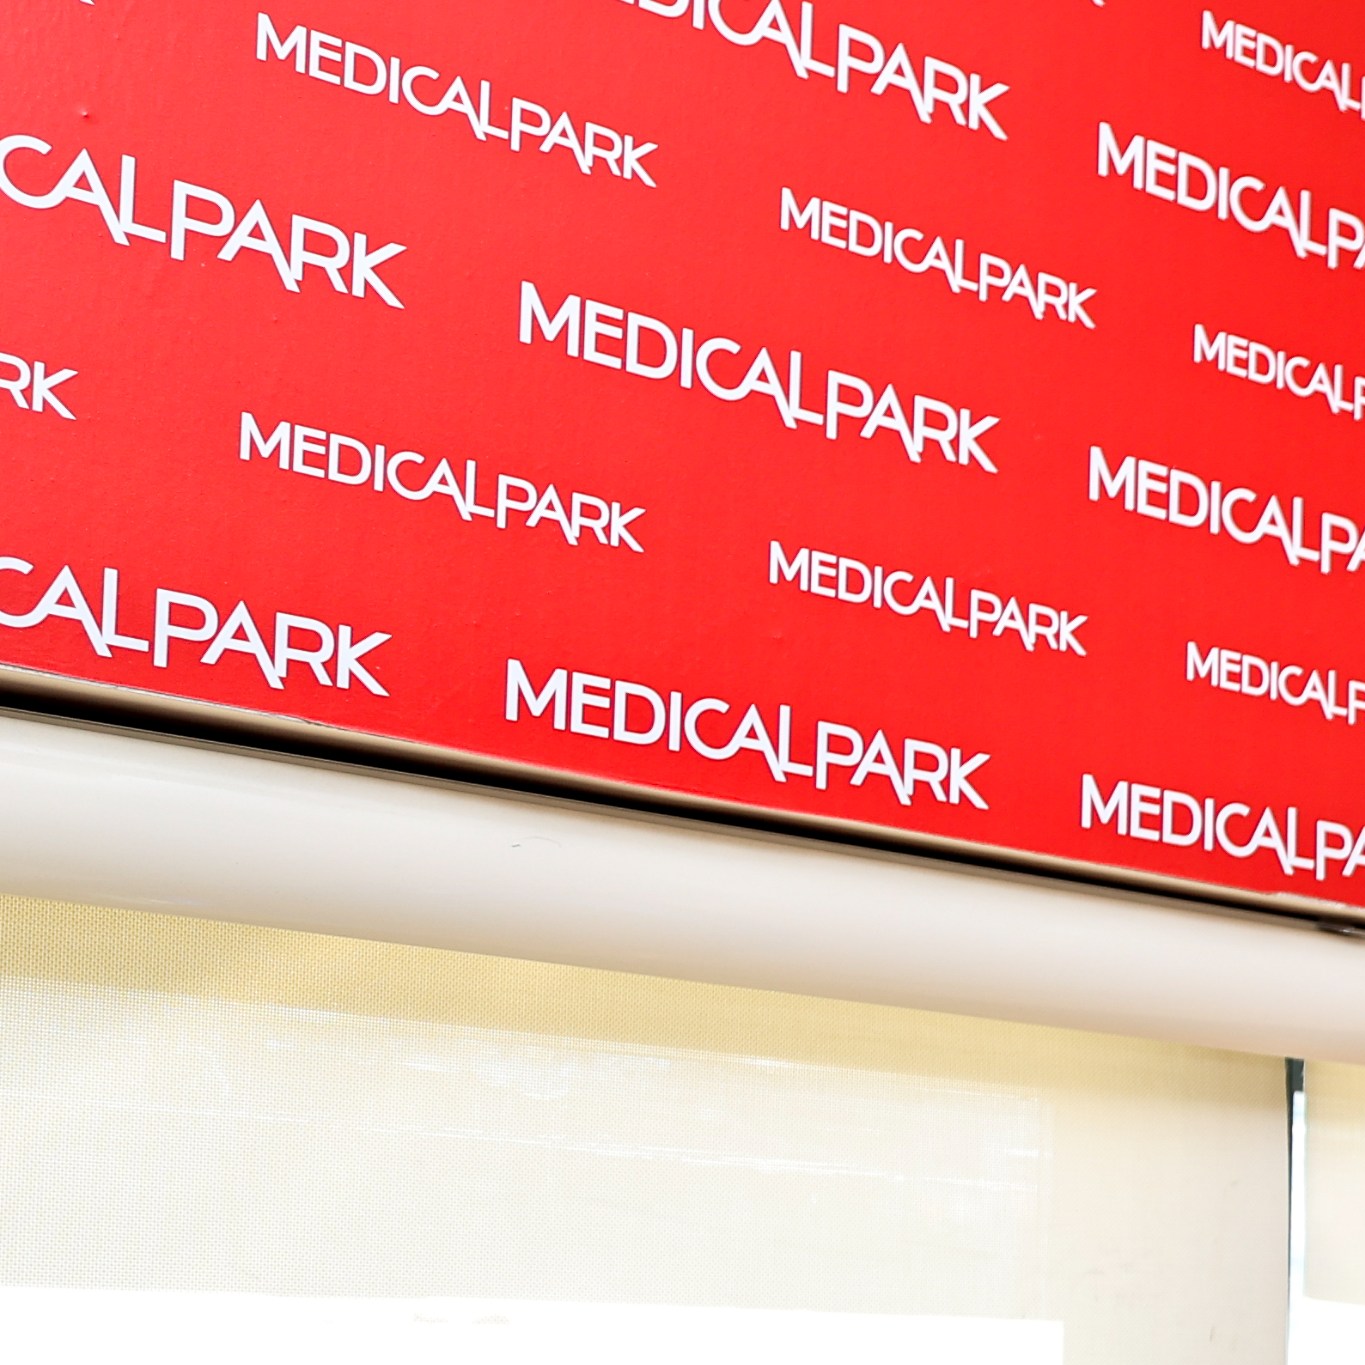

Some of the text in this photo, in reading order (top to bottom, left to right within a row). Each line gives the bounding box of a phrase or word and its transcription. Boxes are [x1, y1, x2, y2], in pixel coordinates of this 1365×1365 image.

[256, 12, 659, 188] MEDICALPARK
[621, 0, 1010, 141] CALPARK
[0, 135, 406, 309] CALPARK
[780, 187, 1097, 329] MEDICALPARK
[519, 280, 1000, 474] MEDICALPARK
[239, 411, 646, 553] MEDICALPARK
[0, 557, 391, 697] CALPARK
[769, 540, 1088, 656] MEDICALPARK
[505, 658, 991, 810] MEDICALPARK
